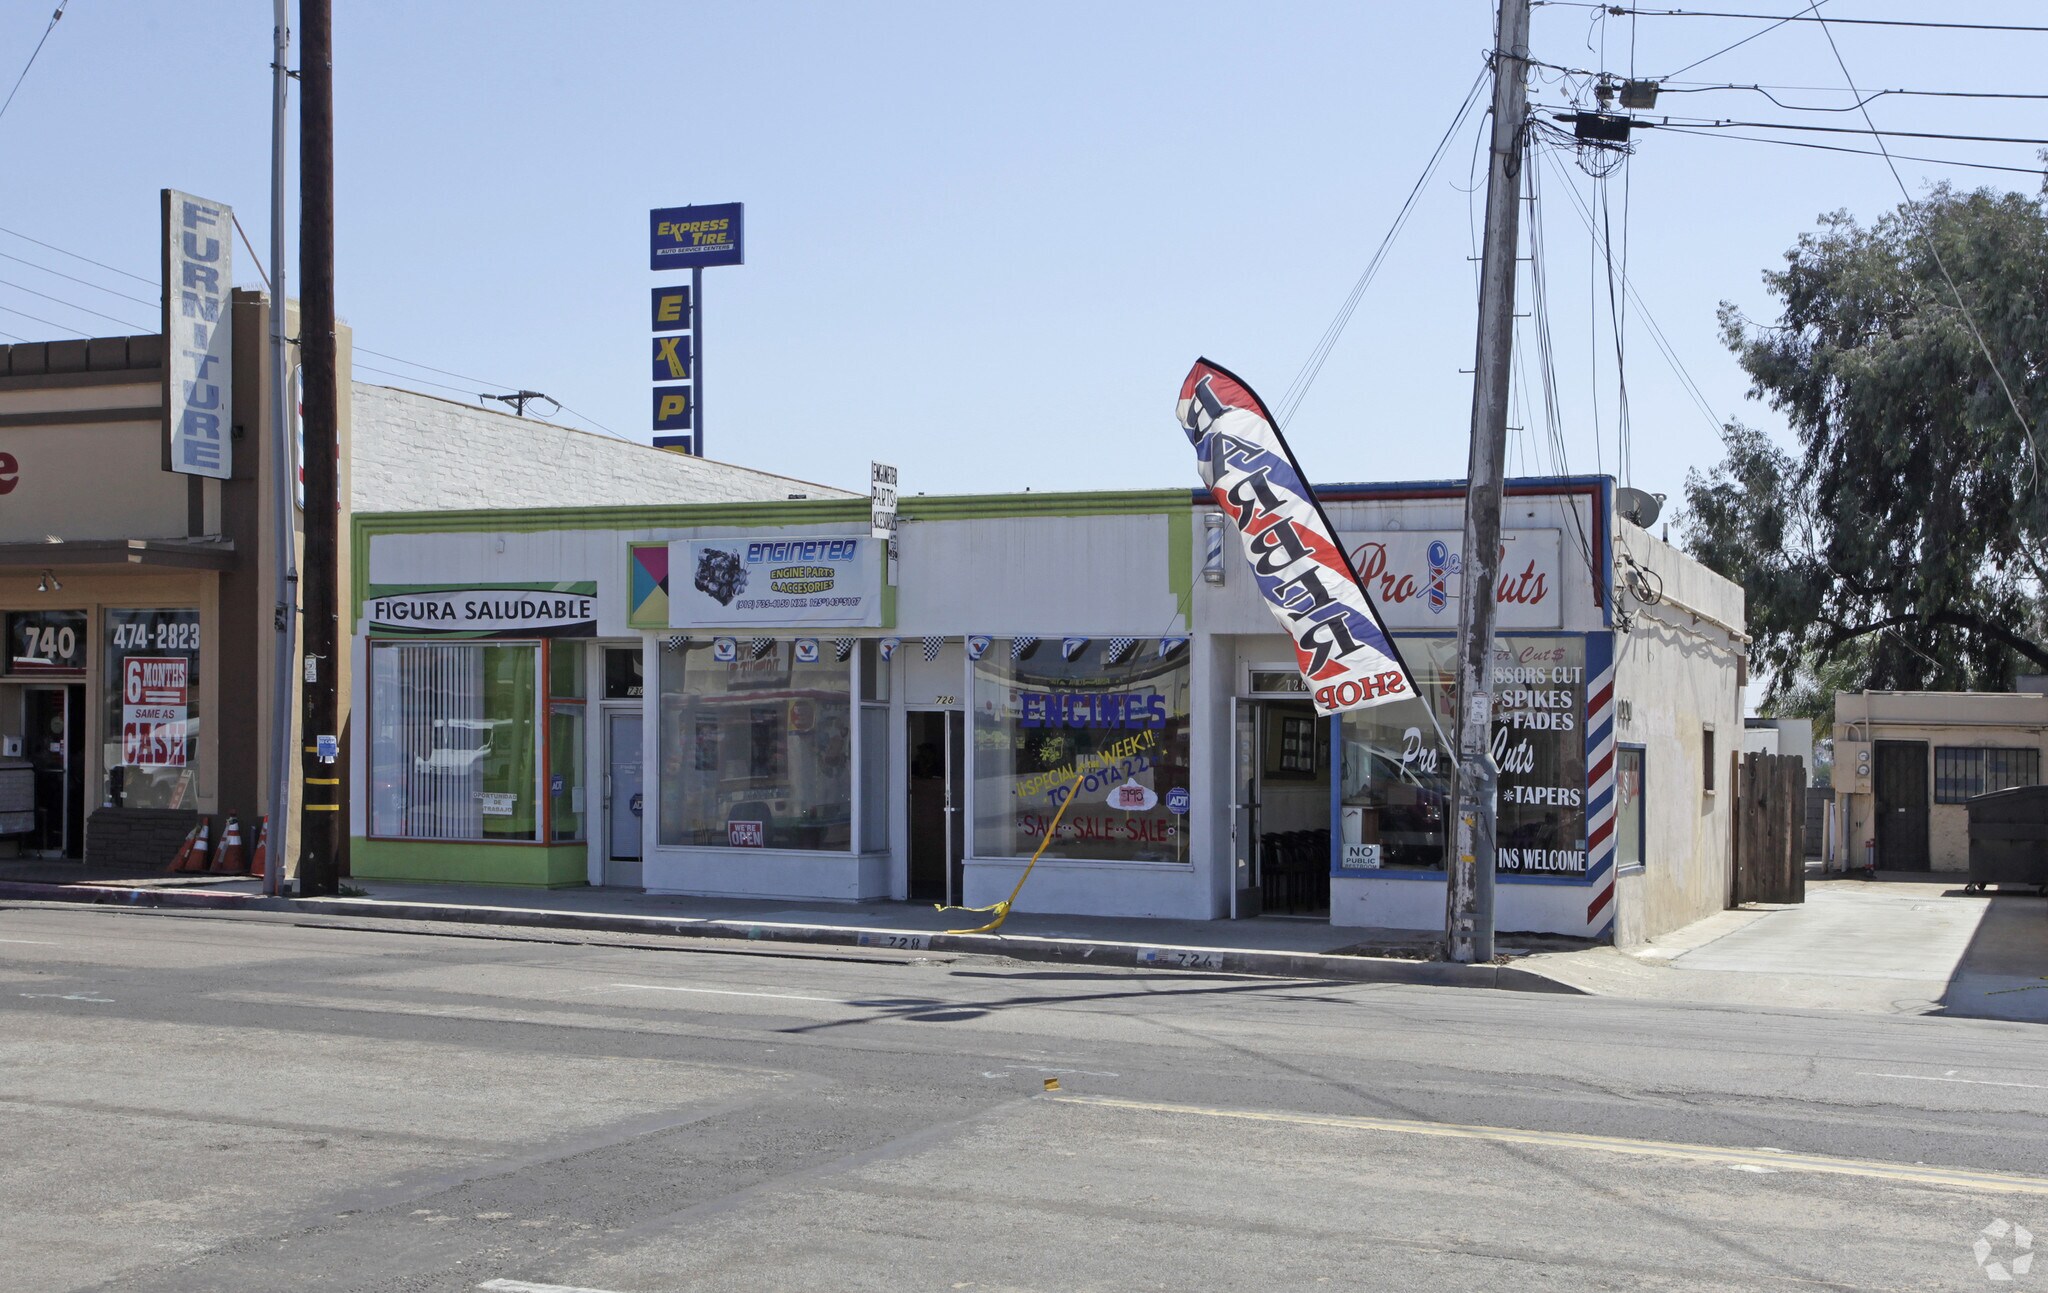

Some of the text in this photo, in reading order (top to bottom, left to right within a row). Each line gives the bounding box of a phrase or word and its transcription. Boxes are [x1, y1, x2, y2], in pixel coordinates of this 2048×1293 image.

[657, 218, 730, 242] EXPRESS
[692, 232, 727, 246] TIRE
[182, 201, 221, 470] FURNITURE
[873, 487, 893, 507] PARTS
[770, 566, 835, 579] ENGINE PARTS
[1350, 542, 1549, 605] Pro uts
[771, 580, 834, 594] & ACCESORIES
[375, 600, 591, 620] FIGURA SALUDABLE
[25, 626, 76, 659] 740
[113, 622, 200, 649] 474-2823
[1494, 652, 1510, 662] ir
[127, 660, 185, 704] 6 MONTHS
[1494, 666, 1583, 684] SSORS CUT
[627, 686, 643, 696] 730
[1286, 679, 1306, 691] 726
[935, 695, 955, 705] 728
[1502, 689, 1573, 709] SPIKES
[135, 708, 175, 719] SAME AS
[1020, 693, 1166, 729] ENGINES
[1513, 712, 1574, 731] FADES
[123, 722, 185, 765] CASH
[1400, 726, 1438, 776] Pro
[551, 781, 563, 790] ADT
[473, 792, 517, 800] OPORTUNIDAD
[1169, 796, 1188, 806] ADT
[1513, 786, 1581, 807] TAPERS
[632, 801, 643, 810] AD
[734, 824, 756, 832] WE'RE
[1024, 815, 1167, 842] SALE SALE SALE
[731, 831, 760, 845] OPEN
[1349, 846, 1373, 857] NO
[1498, 847, 1586, 872] INS WELCOME
[888, 936, 920, 950] 728
